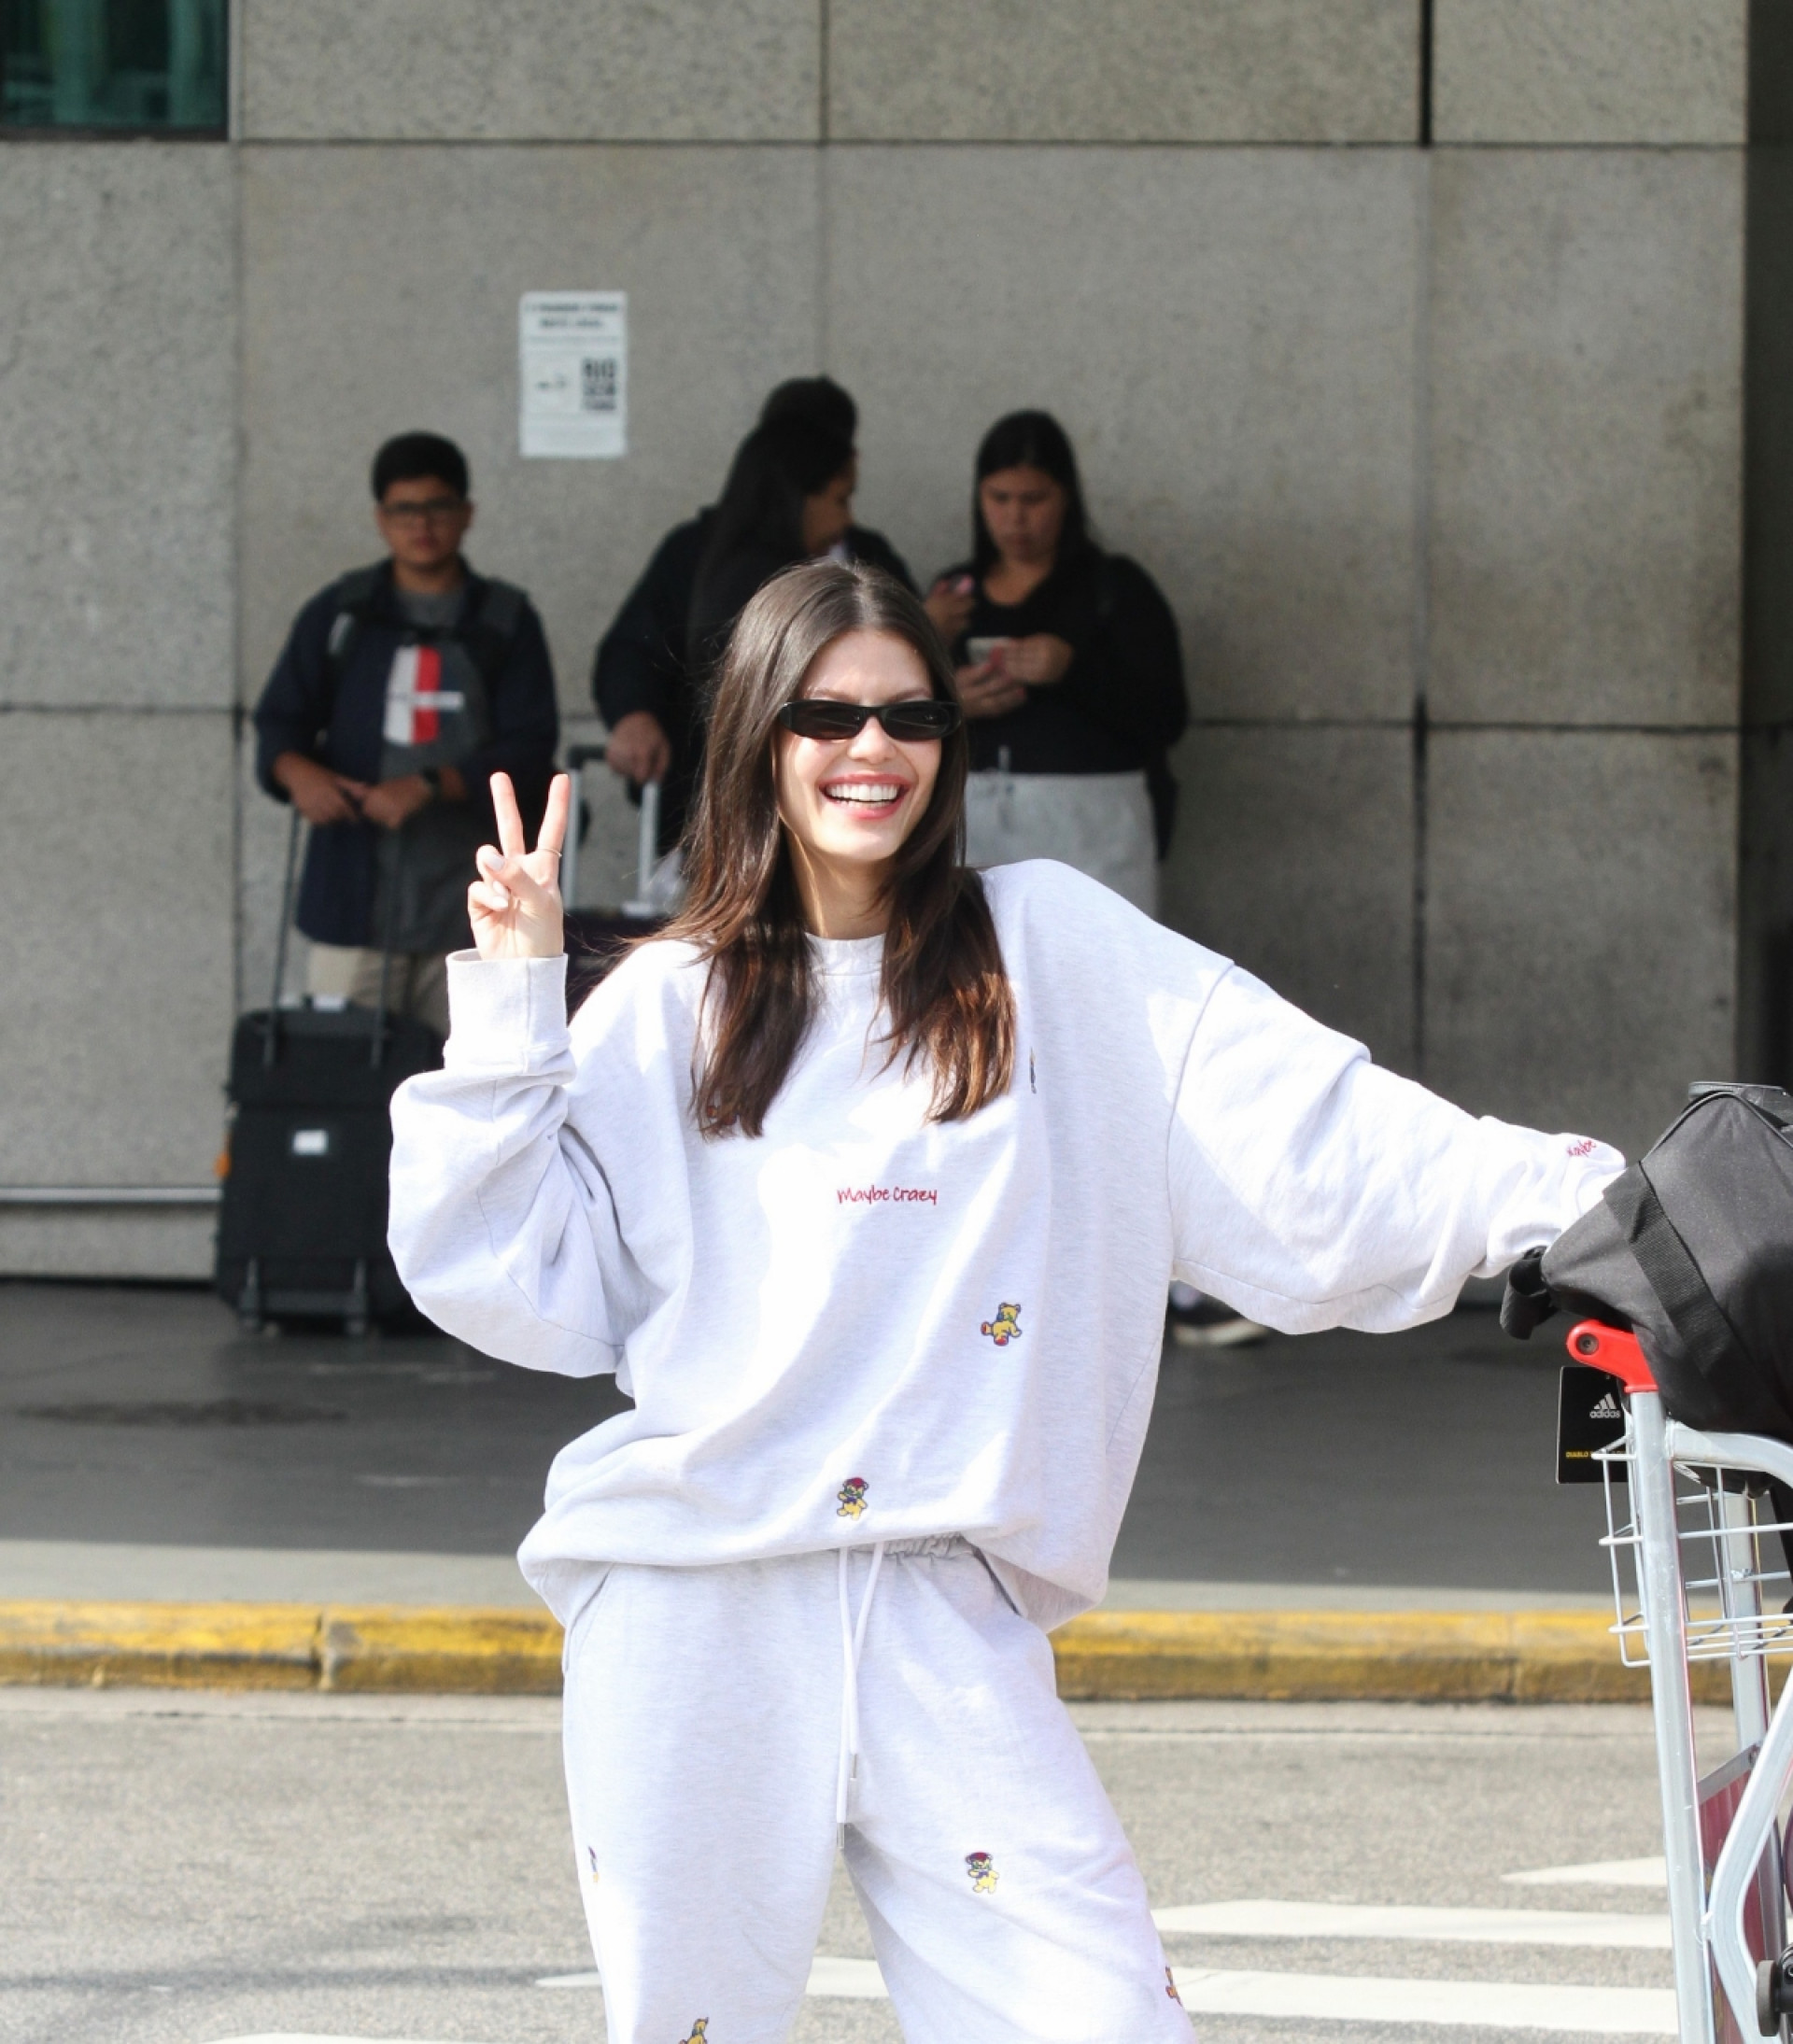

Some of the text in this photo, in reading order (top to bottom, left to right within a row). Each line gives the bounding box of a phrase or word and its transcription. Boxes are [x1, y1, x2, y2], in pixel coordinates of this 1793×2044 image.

[837, 1185, 938, 1205] Maybe Crazy
[1589, 1408, 1620, 1418] adidas
